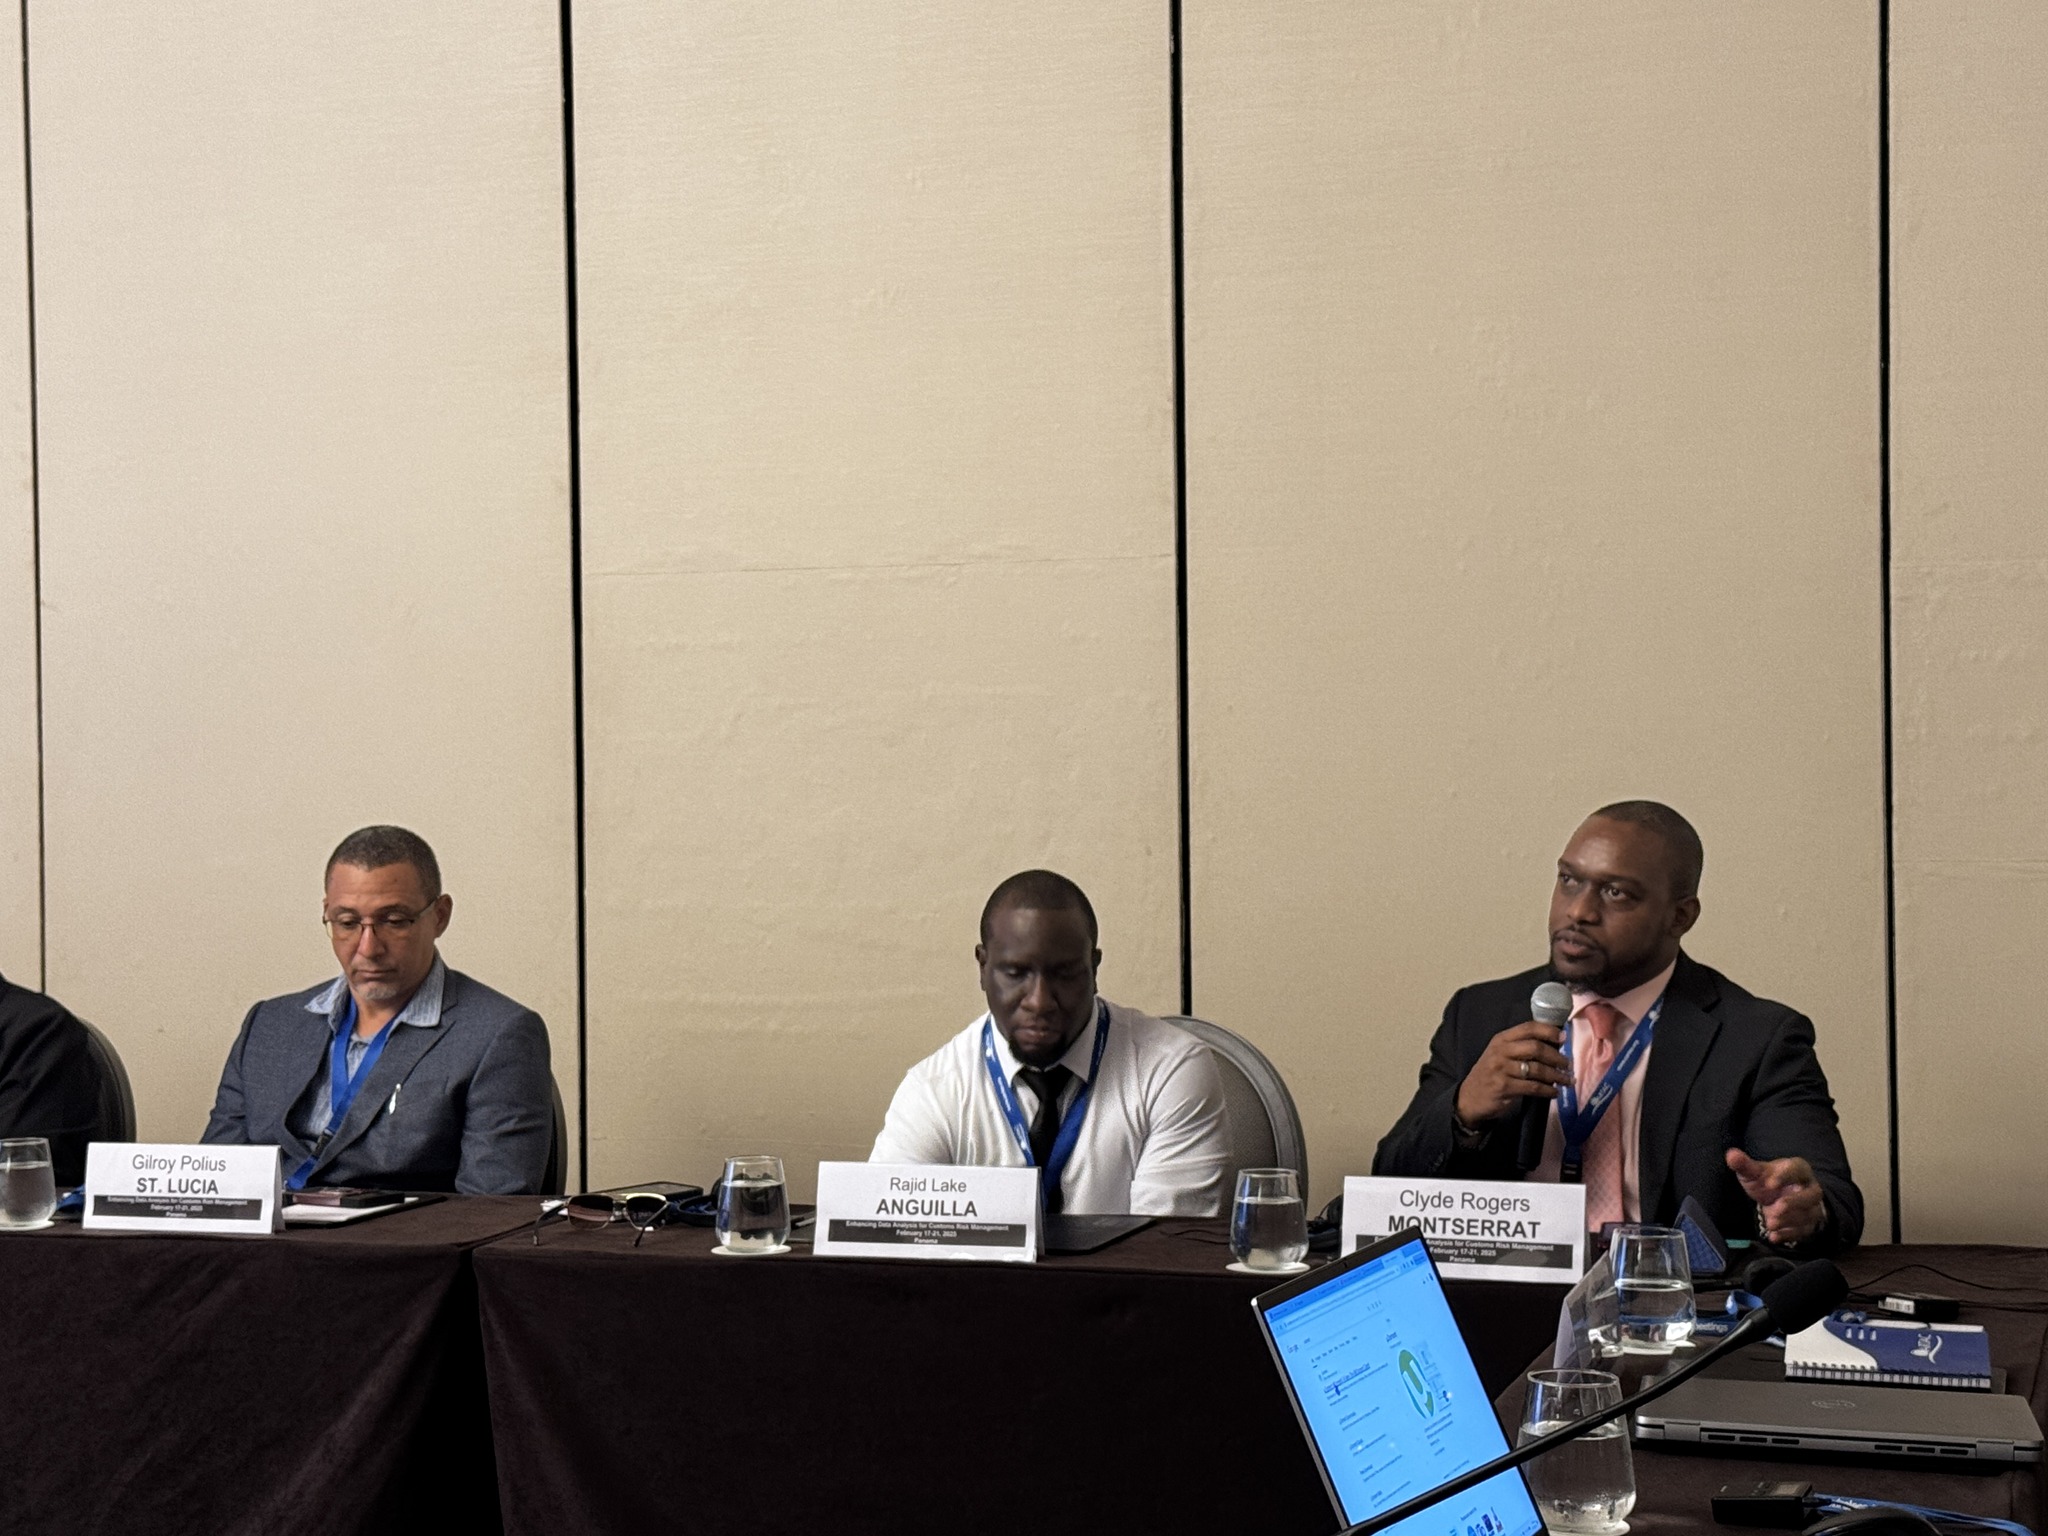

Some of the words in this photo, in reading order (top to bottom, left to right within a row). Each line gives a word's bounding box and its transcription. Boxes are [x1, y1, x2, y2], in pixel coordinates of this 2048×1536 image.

[132, 1154, 176, 1174] Gilroy
[180, 1155, 227, 1171] Polius
[136, 1177, 163, 1193] ST.
[168, 1178, 219, 1194] LUCIA
[890, 1177, 927, 1195] Rajid
[932, 1178, 967, 1193] Lake
[876, 1199, 978, 1217] ANGUILLA
[1400, 1189, 1454, 1211] Clyde
[1460, 1192, 1530, 1214] Rogers
[845, 1220, 877, 1229] Enhancing
[892, 1221, 918, 1229] Analysis
[970, 1224, 1009, 1232] Management
[896, 1229, 923, 1237] February
[1430, 1247, 1459, 1256] February
[1460, 1248, 1480, 1256] 17-21,
[1511, 1243, 1554, 1252] Management
